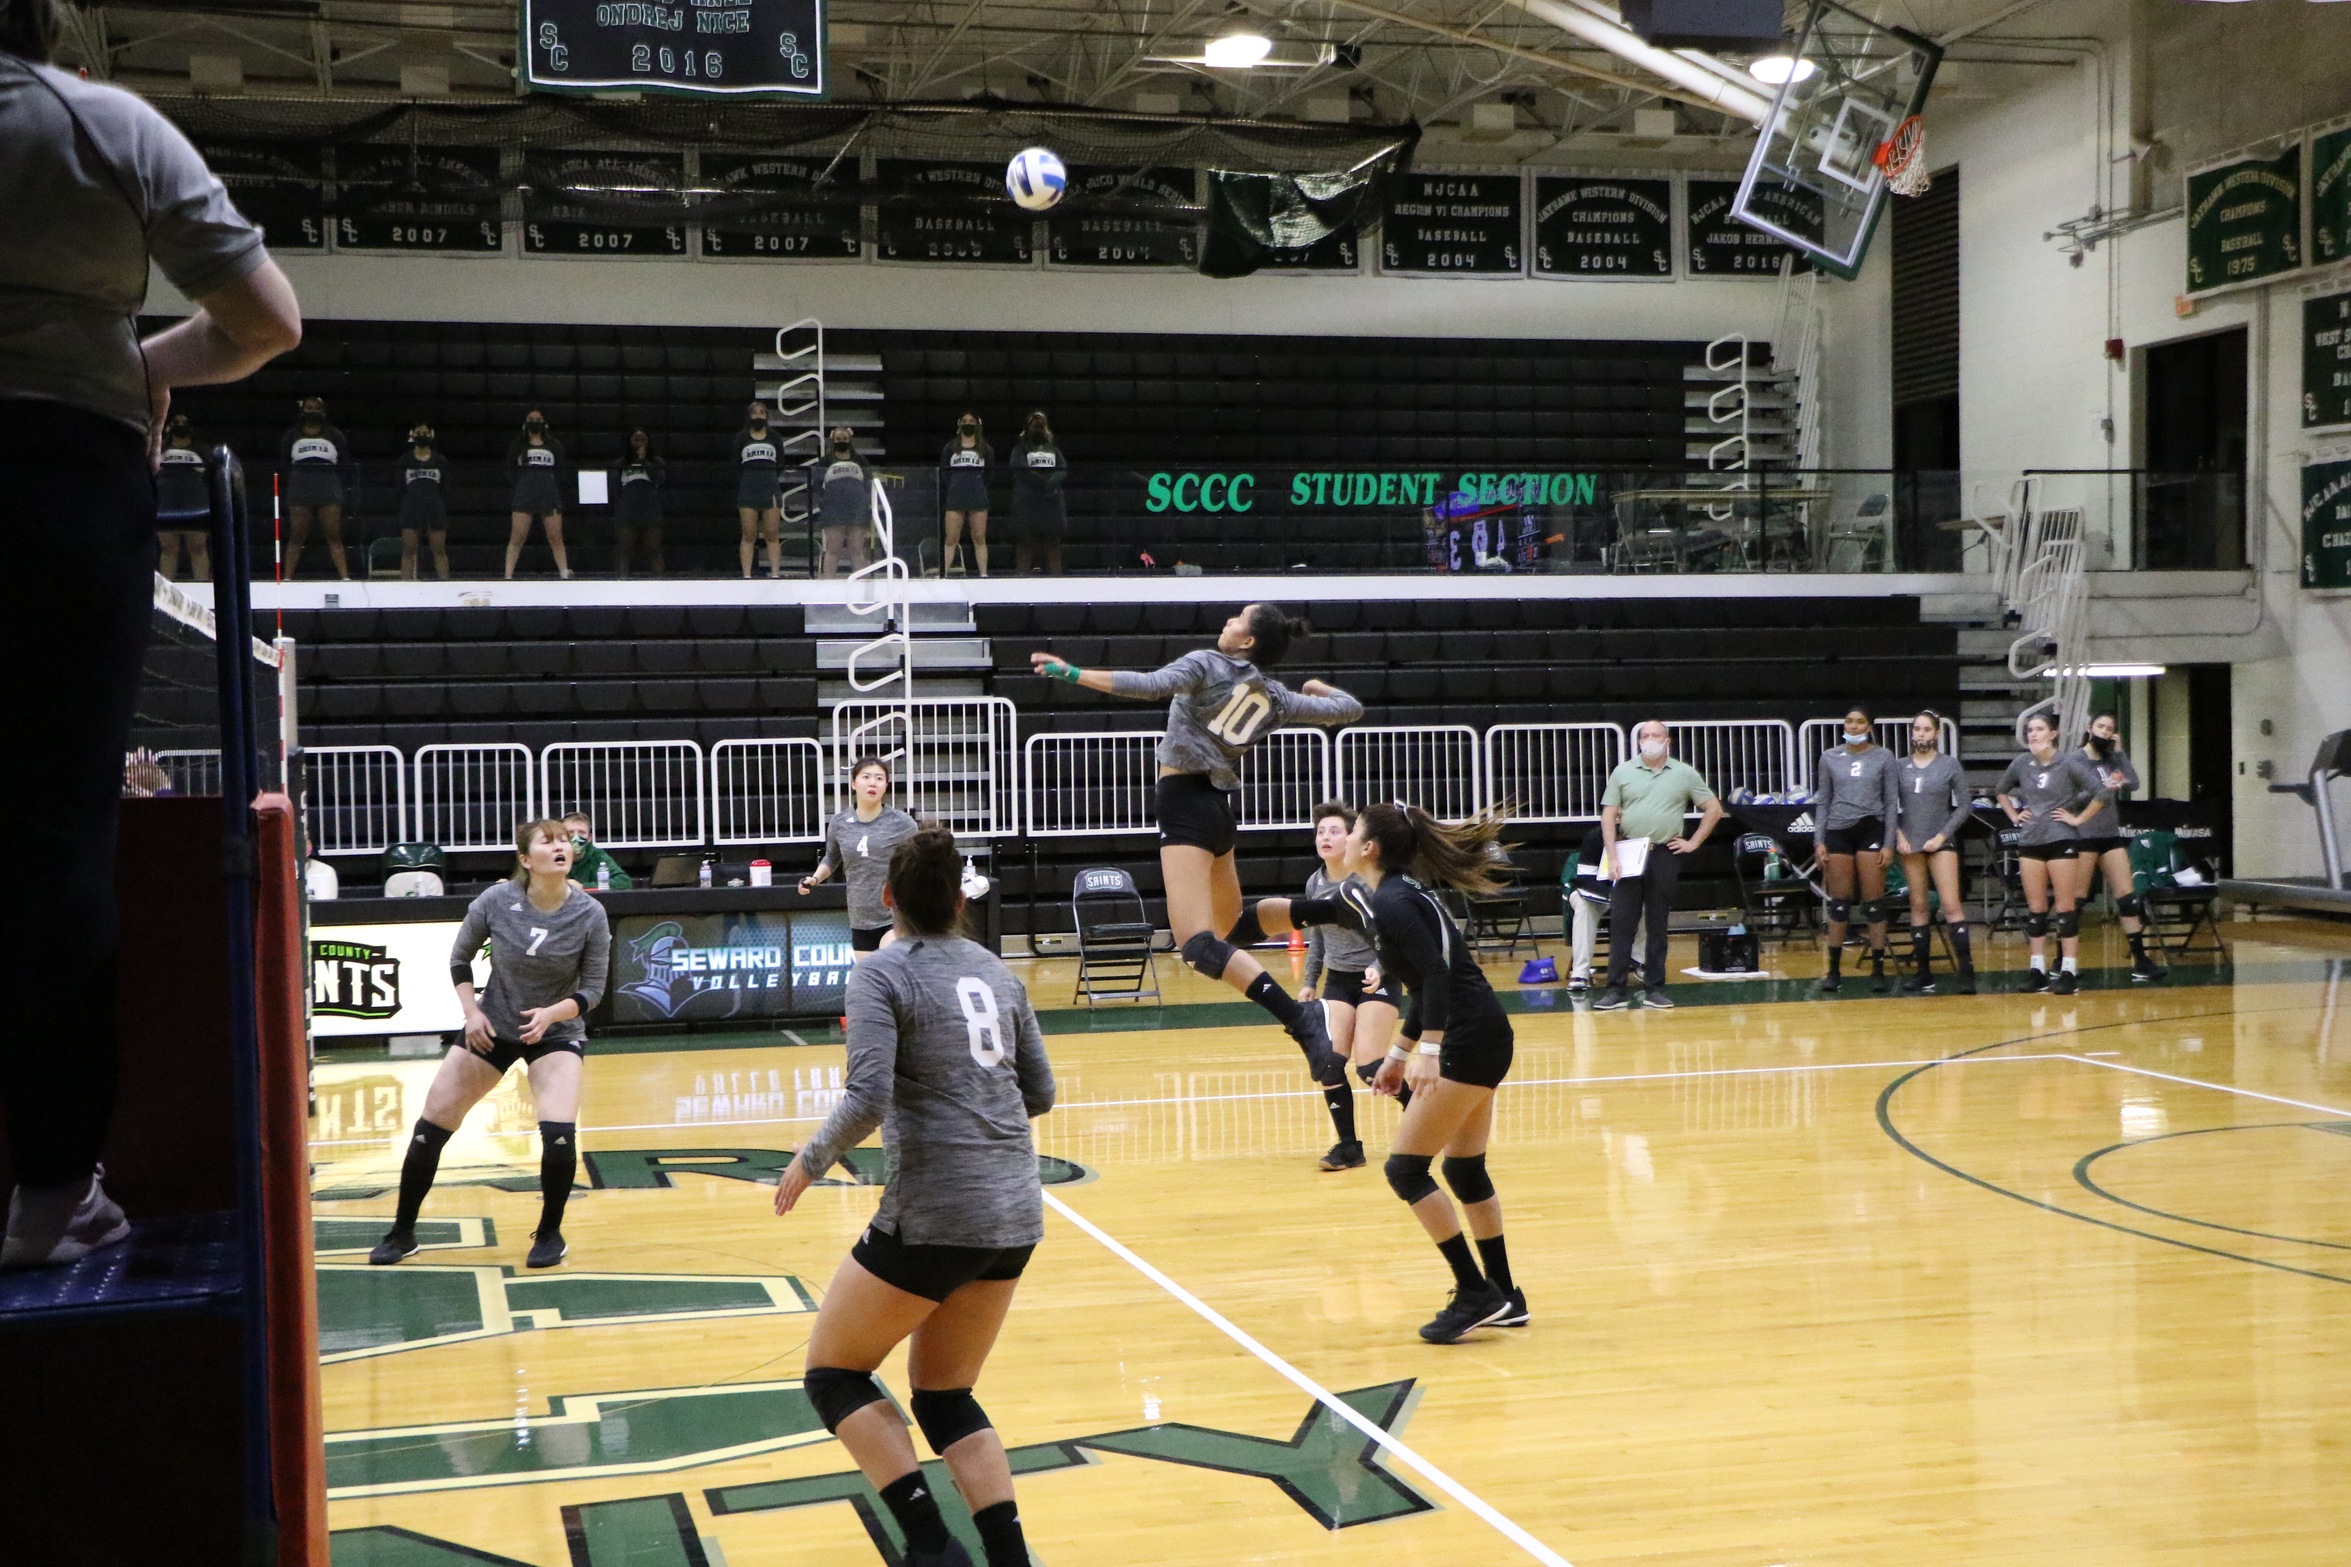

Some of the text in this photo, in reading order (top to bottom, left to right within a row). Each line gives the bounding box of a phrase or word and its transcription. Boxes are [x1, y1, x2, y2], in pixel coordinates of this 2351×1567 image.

[596, 5, 750, 34] ONDREJ NICE
[632, 44, 723, 78] 2016
[1424, 183, 1480, 197] NJCAA
[1450, 205, 1510, 218] CHAMPIONS
[1628, 191, 1668, 225] DIVISION
[1572, 211, 1635, 224] CHAMPIONS
[392, 227, 449, 243] 2007
[578, 233, 633, 248] 2007
[1418, 229, 1487, 243] BASEBALL
[1567, 231, 1641, 245] BASEBALL
[754, 236, 809, 251] 2007
[1427, 253, 1475, 267] 2004
[1580, 255, 1628, 269] 2004
[2227, 255, 2256, 276] 1975
[1145, 471, 1255, 513] SCCC
[1289, 472, 1442, 506] STUDENT
[1458, 473, 1597, 506] SECTION
[1207, 683, 1270, 745] 10
[1850, 761, 1862, 777] 2
[1914, 777, 1922, 794] 1
[2037, 773, 2048, 789] 3
[856, 835, 869, 857] 4
[1745, 840, 1773, 850] SAINTS
[1087, 874, 1121, 887] SAINTS
[526, 927, 549, 957] 7
[320, 944, 371, 960] COUNTY
[671, 942, 857, 972] SEWARD COUN
[313, 960, 397, 1008] NTS
[956, 977, 1005, 1067] 8
